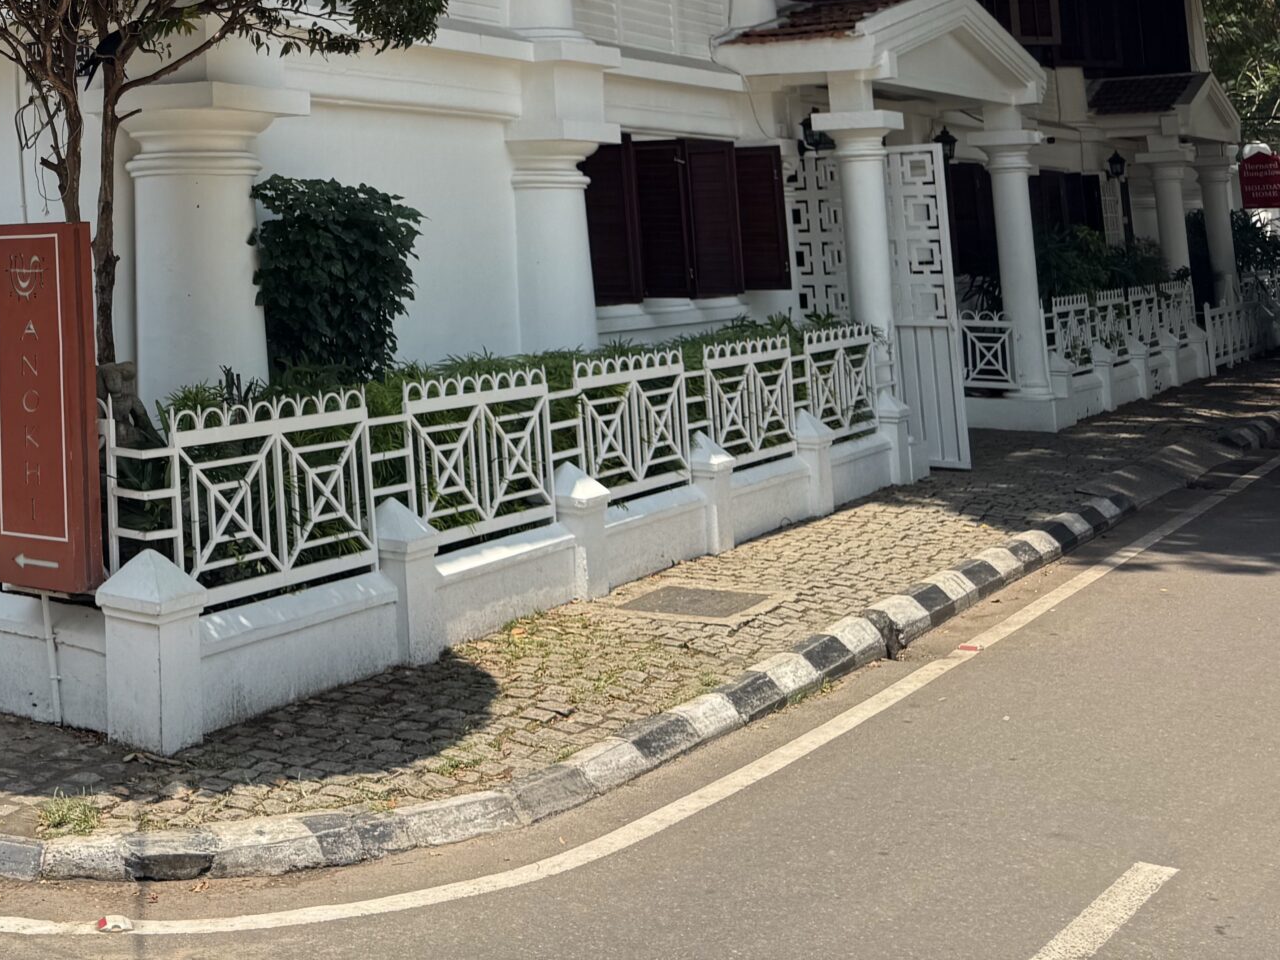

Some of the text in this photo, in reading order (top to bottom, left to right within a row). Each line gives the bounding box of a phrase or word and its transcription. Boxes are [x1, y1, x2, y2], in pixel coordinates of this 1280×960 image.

[1244, 162, 1279, 170] Bernard
[1251, 190, 1279, 198] HOME
[20, 319, 41, 521] ANOKHI
